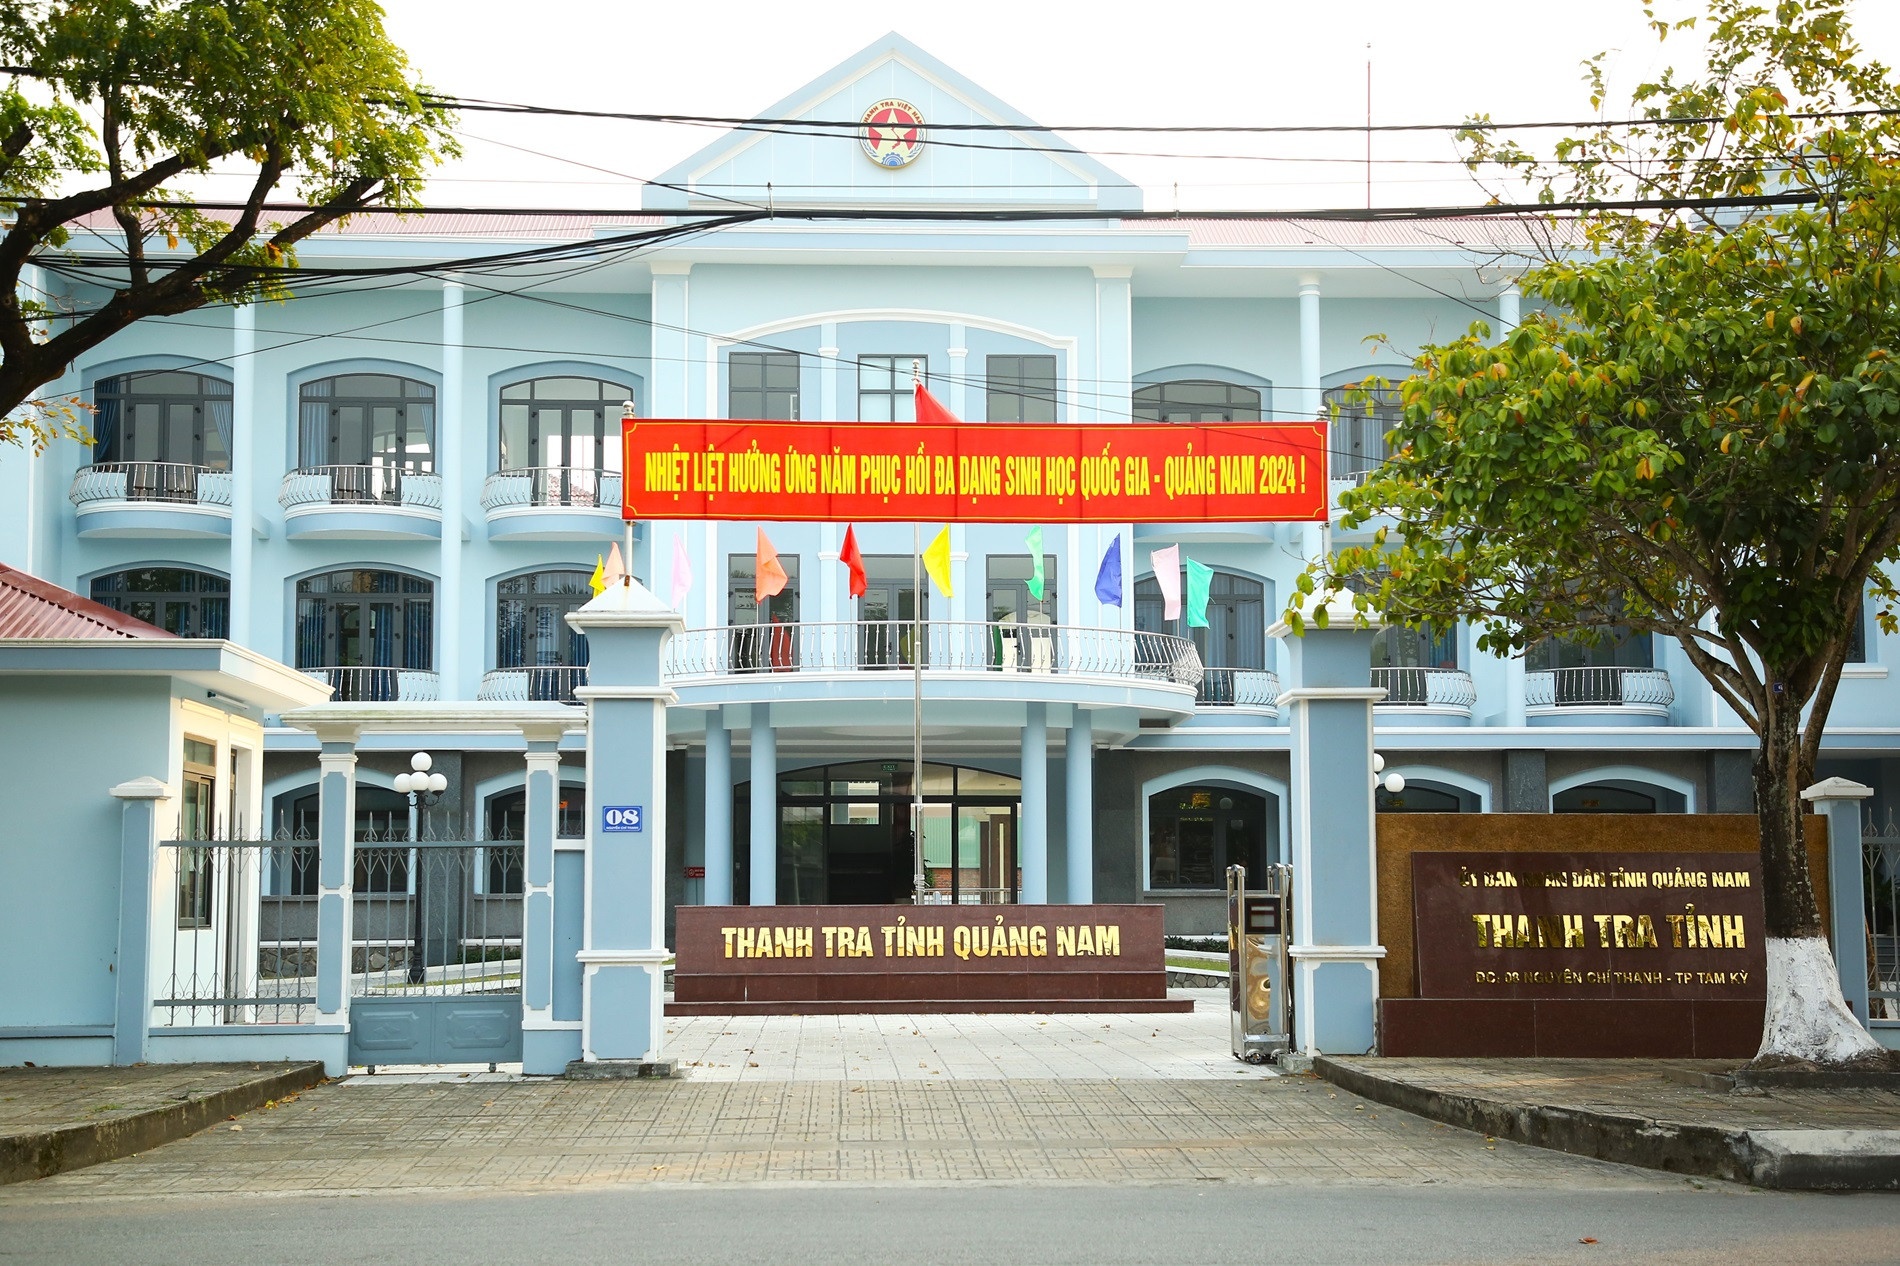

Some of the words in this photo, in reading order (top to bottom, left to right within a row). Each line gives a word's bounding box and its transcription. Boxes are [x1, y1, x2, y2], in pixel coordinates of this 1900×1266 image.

[863, 105, 879, 123] HANH
[645, 443, 690, 501] NHIỆT
[694, 443, 724, 501] LIỆT
[729, 439, 781, 494] HƯỞNG
[785, 445, 816, 494] ỨNG
[820, 446, 857, 495] NĂM
[861, 454, 901, 504] PHỤC
[905, 441, 931, 495] HỒI
[934, 455, 956, 496] ĐA
[959, 455, 1001, 504] DẠNG
[1005, 455, 1042, 496] SINH
[1045, 455, 1076, 505] HỌC
[1080, 442, 1121, 501] QUỐC
[1125, 455, 1150, 496] GIA
[1153, 474, 1161, 483] -
[1164, 442, 1216, 501] QUẢNG
[1219, 455, 1256, 495] NAM
[1259, 454, 1296, 495] 2024
[606, 809, 639, 825] 08
[1484, 871, 1518, 888] BAN
[1571, 869, 1606, 888] DÂN
[1610, 867, 1648, 888] TỈNH
[1651, 867, 1708, 889] QUẢNG
[1712, 871, 1751, 888] NAM
[1472, 914, 1586, 949] THANH
[1593, 914, 1659, 949] TRA
[1665, 903, 1746, 949] TỈNH
[721, 926, 813, 958] THANH
[821, 926, 874, 958] TRA
[881, 915, 944, 957] TỈNH
[953, 915, 1048, 961] QUẢNG
[1055, 925, 1121, 957] NAM
[1613, 971, 1662, 984] THANH
[1674, 971, 1693, 984] TP
[1696, 971, 1726, 984] TAM
[1729, 969, 1749, 984] KỲ
